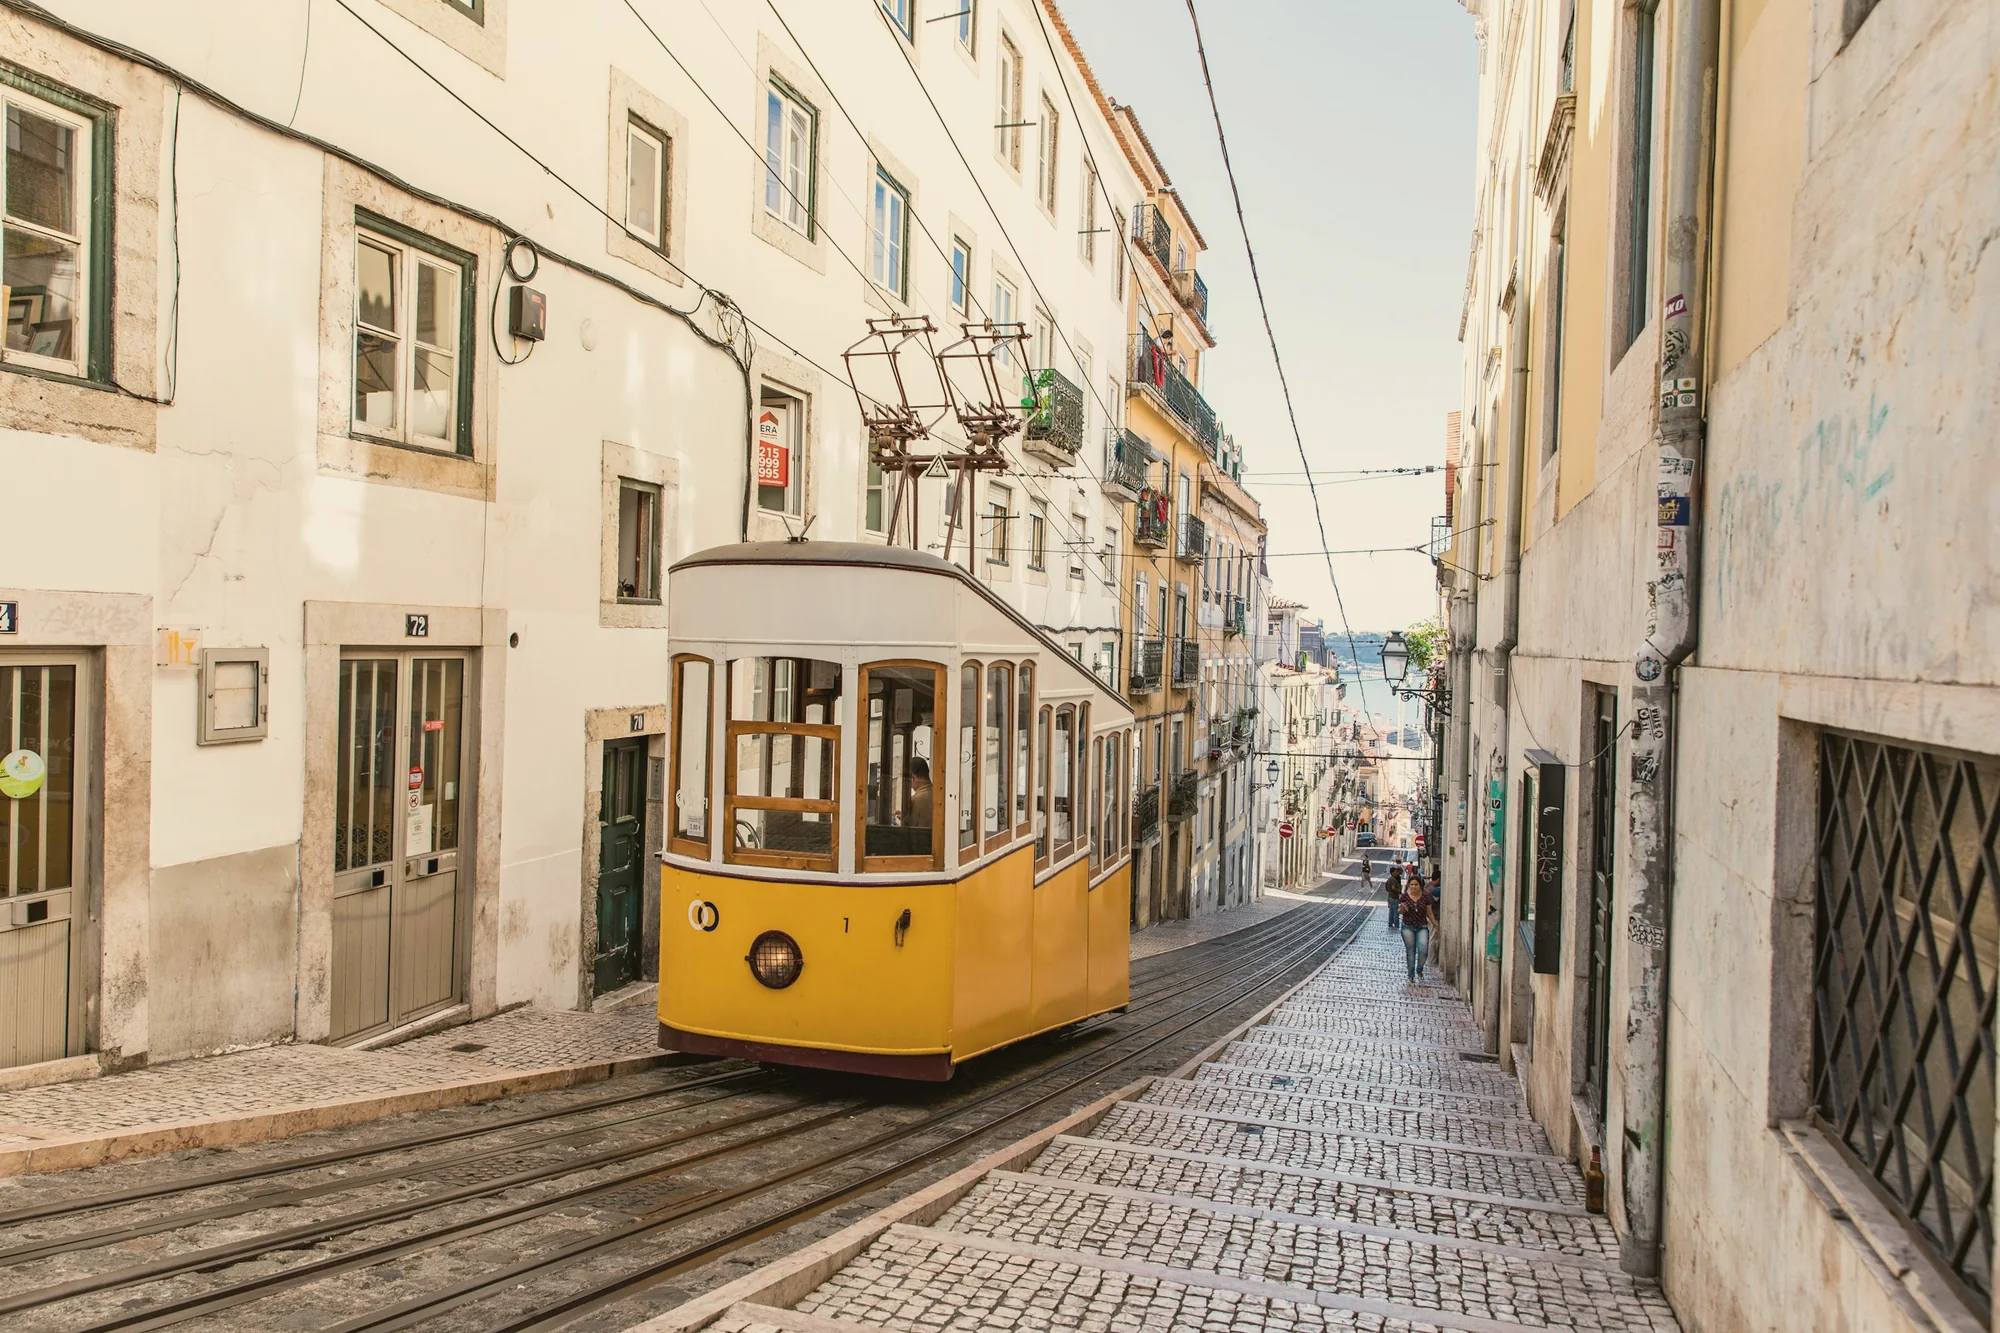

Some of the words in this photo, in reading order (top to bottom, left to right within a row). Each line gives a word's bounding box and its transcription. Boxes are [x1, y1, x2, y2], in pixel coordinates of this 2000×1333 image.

[760, 424, 778, 434] ERA
[759, 446, 780, 459] 215
[759, 457, 780, 469] 999
[758, 467, 780, 479] 995
[410, 615, 426, 636] 72
[633, 715, 643, 730] 70
[843, 917, 849, 933] 1
